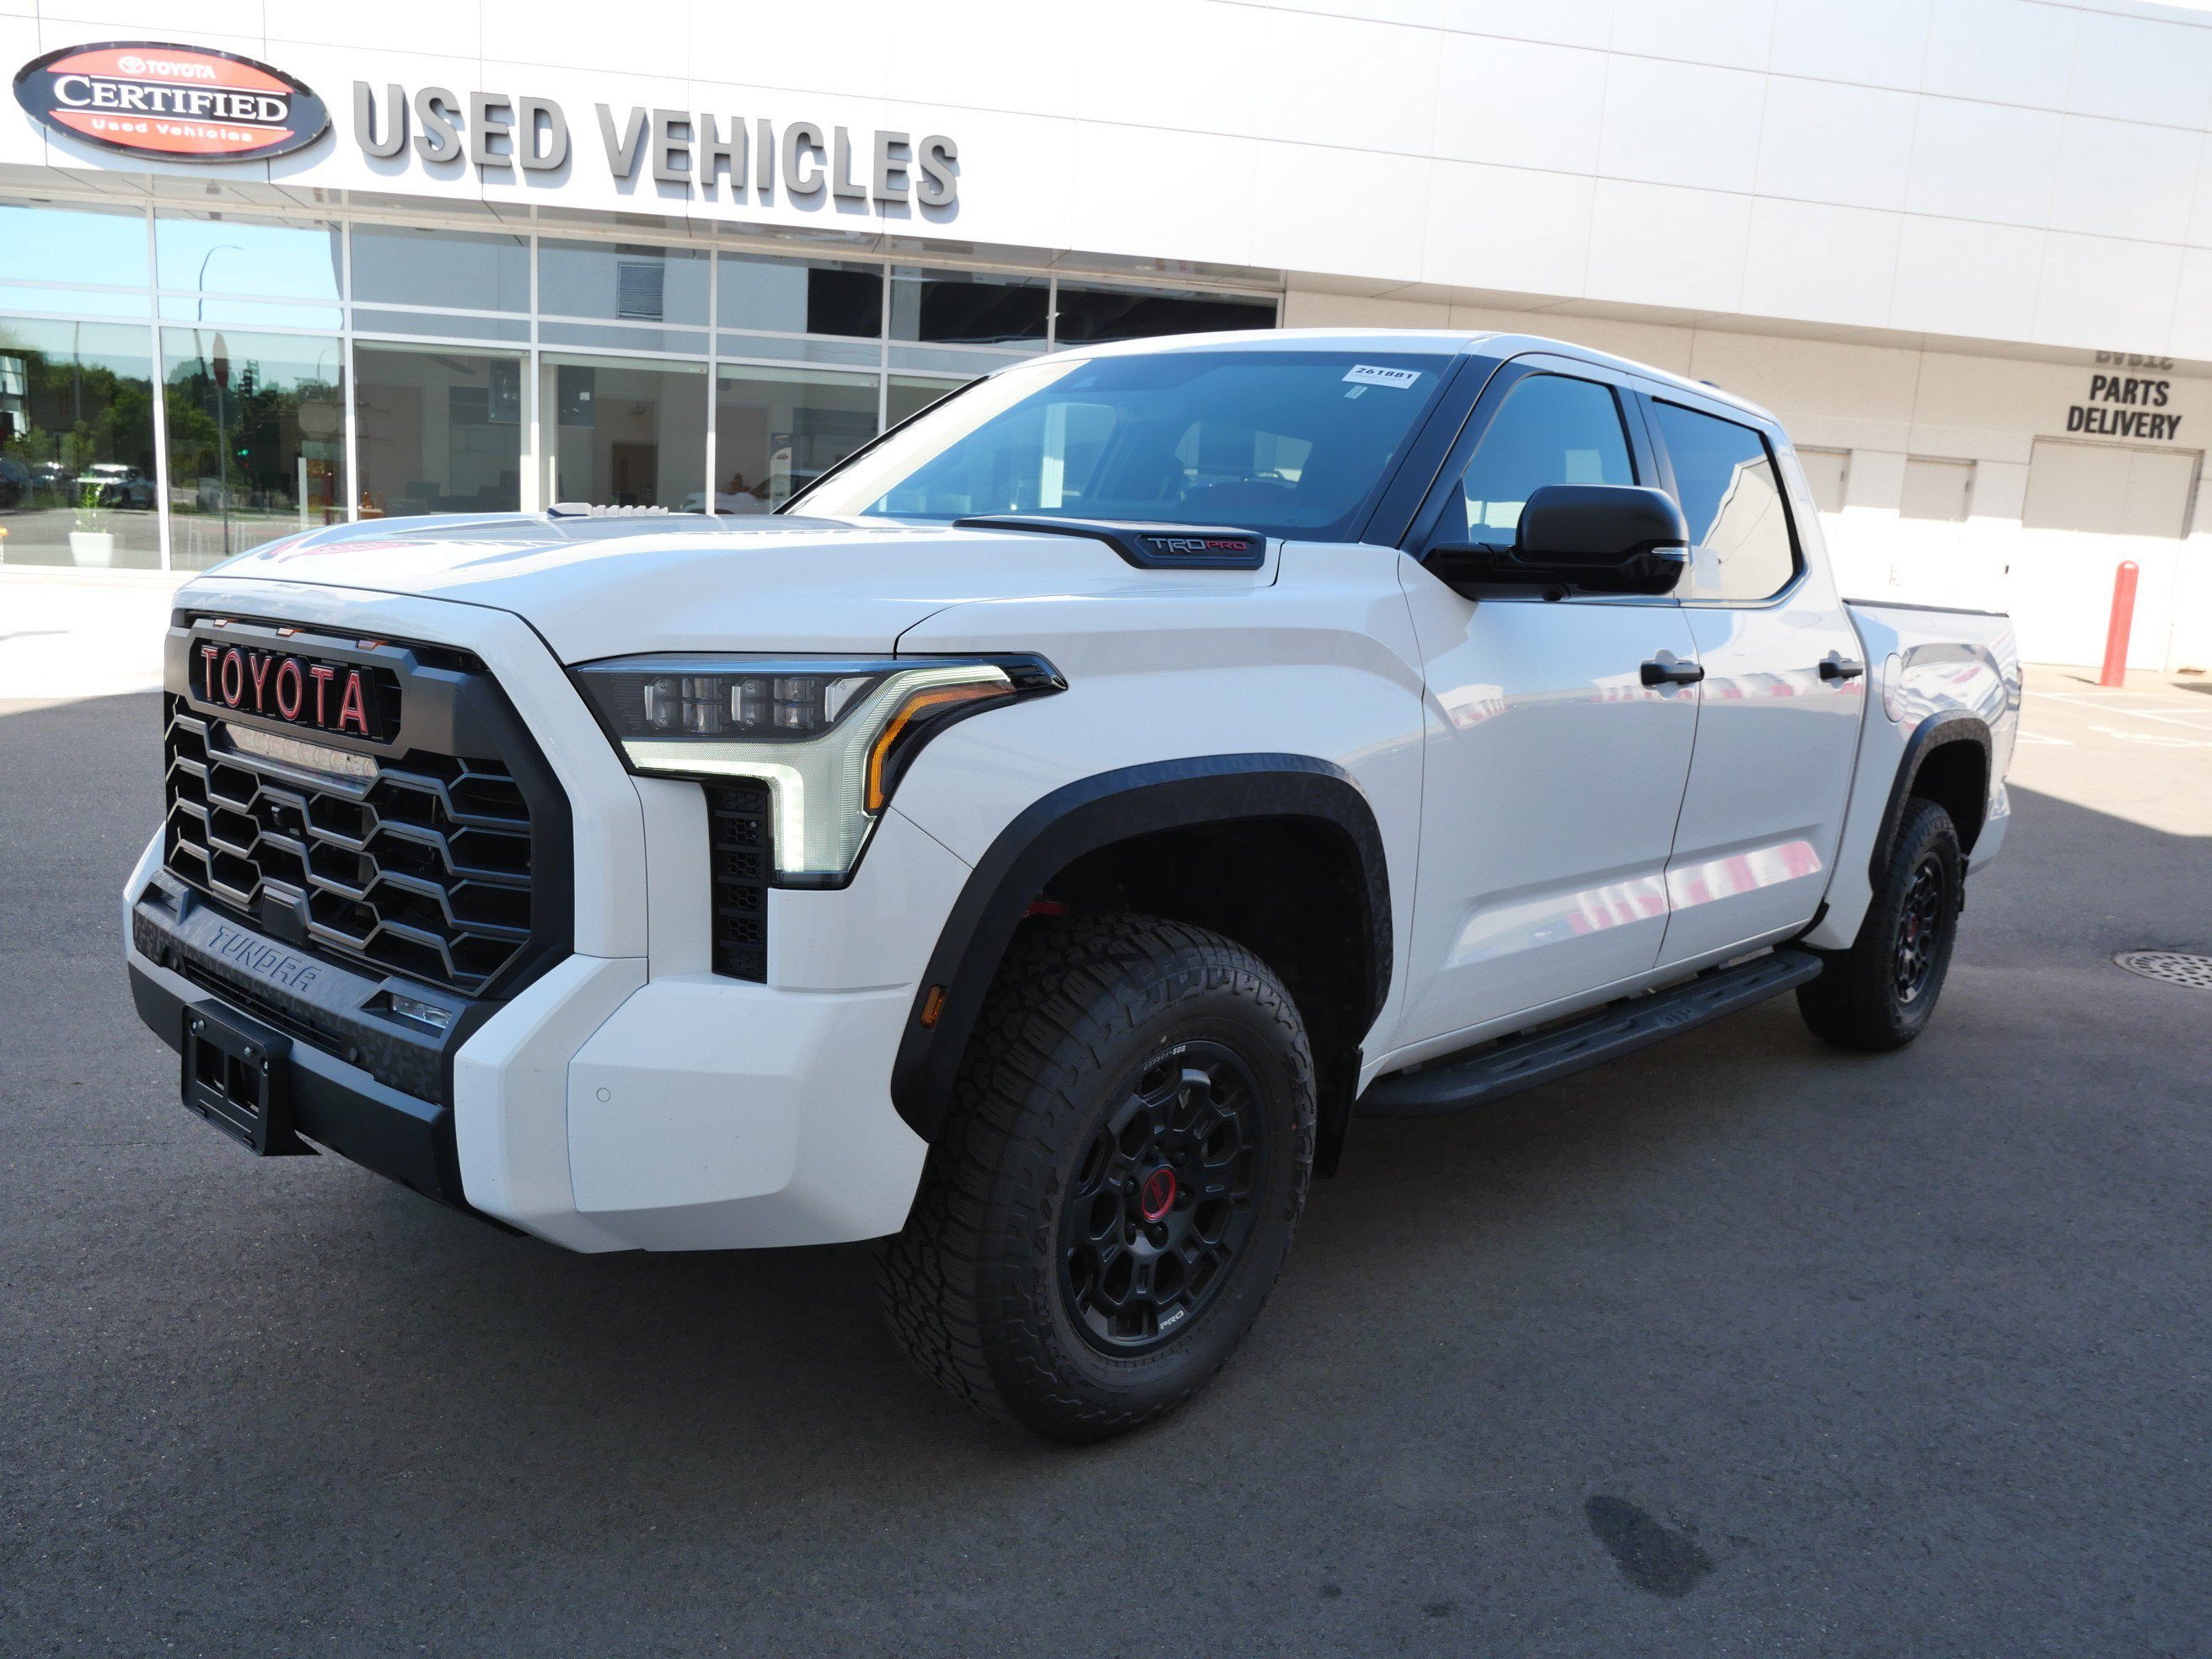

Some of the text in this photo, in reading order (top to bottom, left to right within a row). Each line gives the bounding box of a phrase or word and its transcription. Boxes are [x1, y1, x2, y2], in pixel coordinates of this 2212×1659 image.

[146, 59, 217, 79] TOYOTA
[91, 118, 254, 142] Used Vehicles
[352, 80, 960, 207] USED VEHICLES
[1356, 368, 1414, 379] 261881
[2089, 375, 2170, 406] PARTS
[2067, 406, 2182, 440] DELIVERY
[1146, 537, 1247, 554] TRD PRO
[201, 644, 369, 736] TOYOTA
[208, 926, 323, 993] TUNDRA
[1159, 1310, 1184, 1330] PRO
